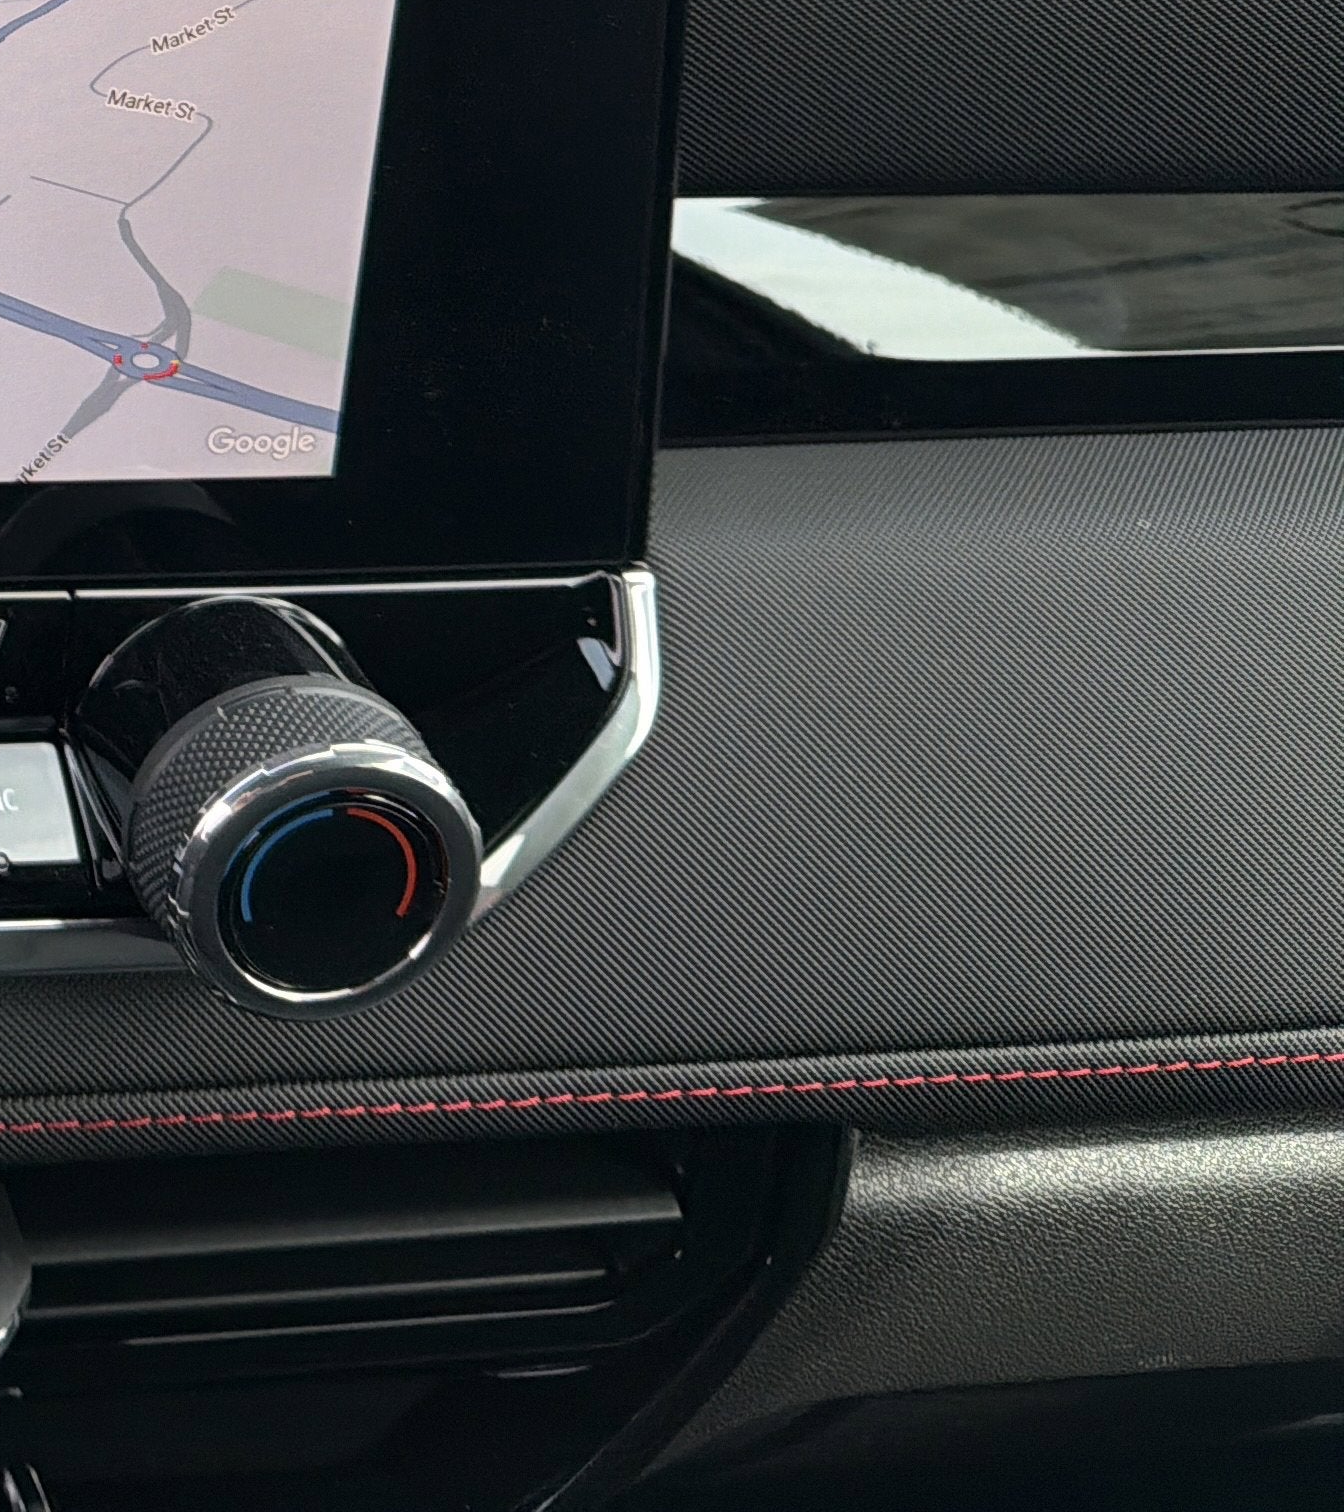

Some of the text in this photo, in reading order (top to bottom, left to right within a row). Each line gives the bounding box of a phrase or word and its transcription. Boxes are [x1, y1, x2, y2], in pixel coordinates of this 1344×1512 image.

[151, 6, 235, 53] Market St
[107, 89, 196, 121] Market St
[47, 434, 70, 453] St
[208, 428, 315, 459] Google
